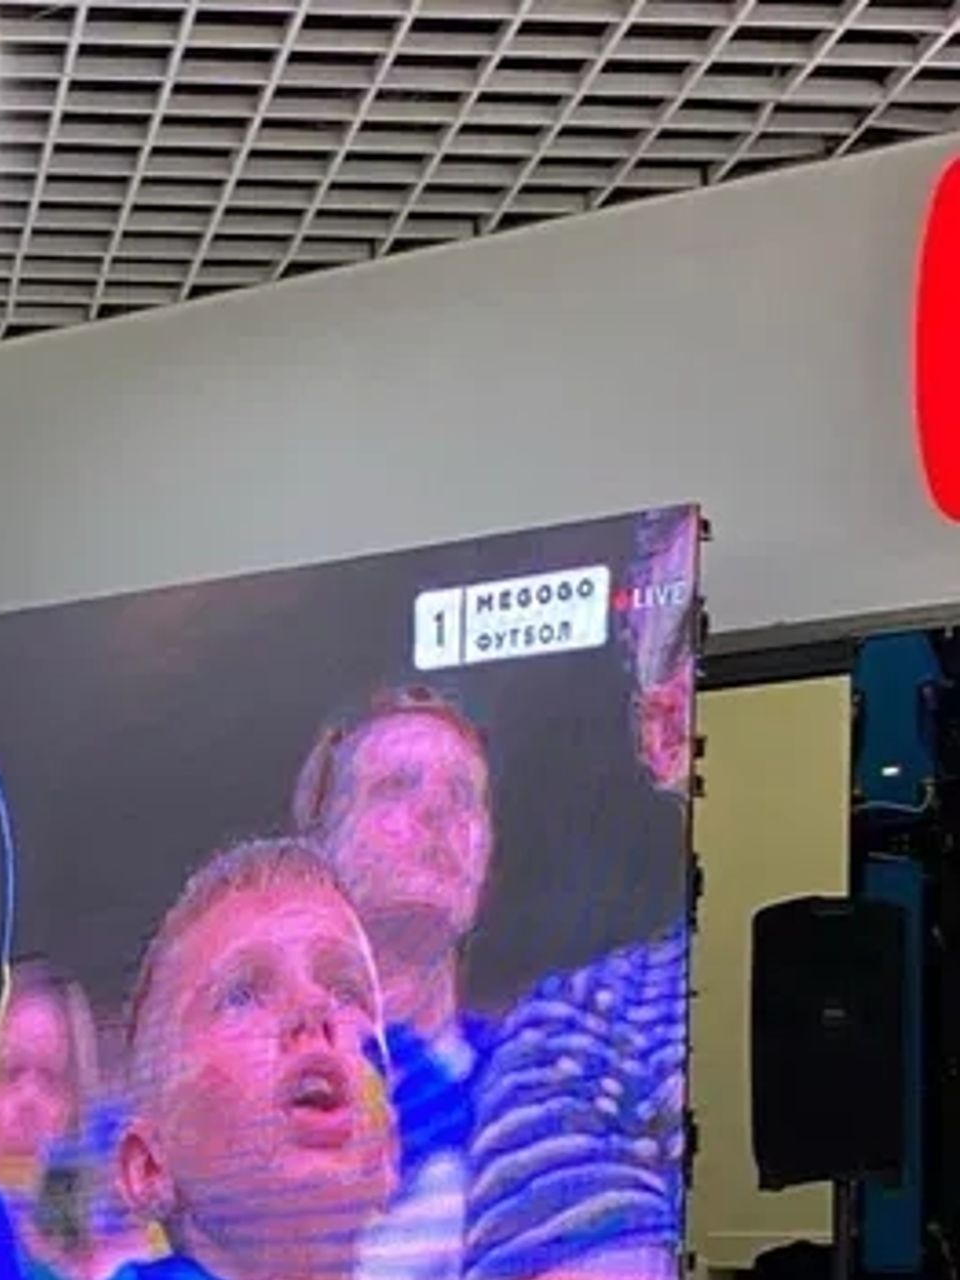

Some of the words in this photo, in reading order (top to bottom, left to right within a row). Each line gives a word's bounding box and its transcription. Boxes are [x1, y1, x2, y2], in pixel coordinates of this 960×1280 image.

[433, 611, 446, 647] 1
[632, 581, 687, 609] LIVE
[475, 621, 573, 651] ФУТБОЛ
